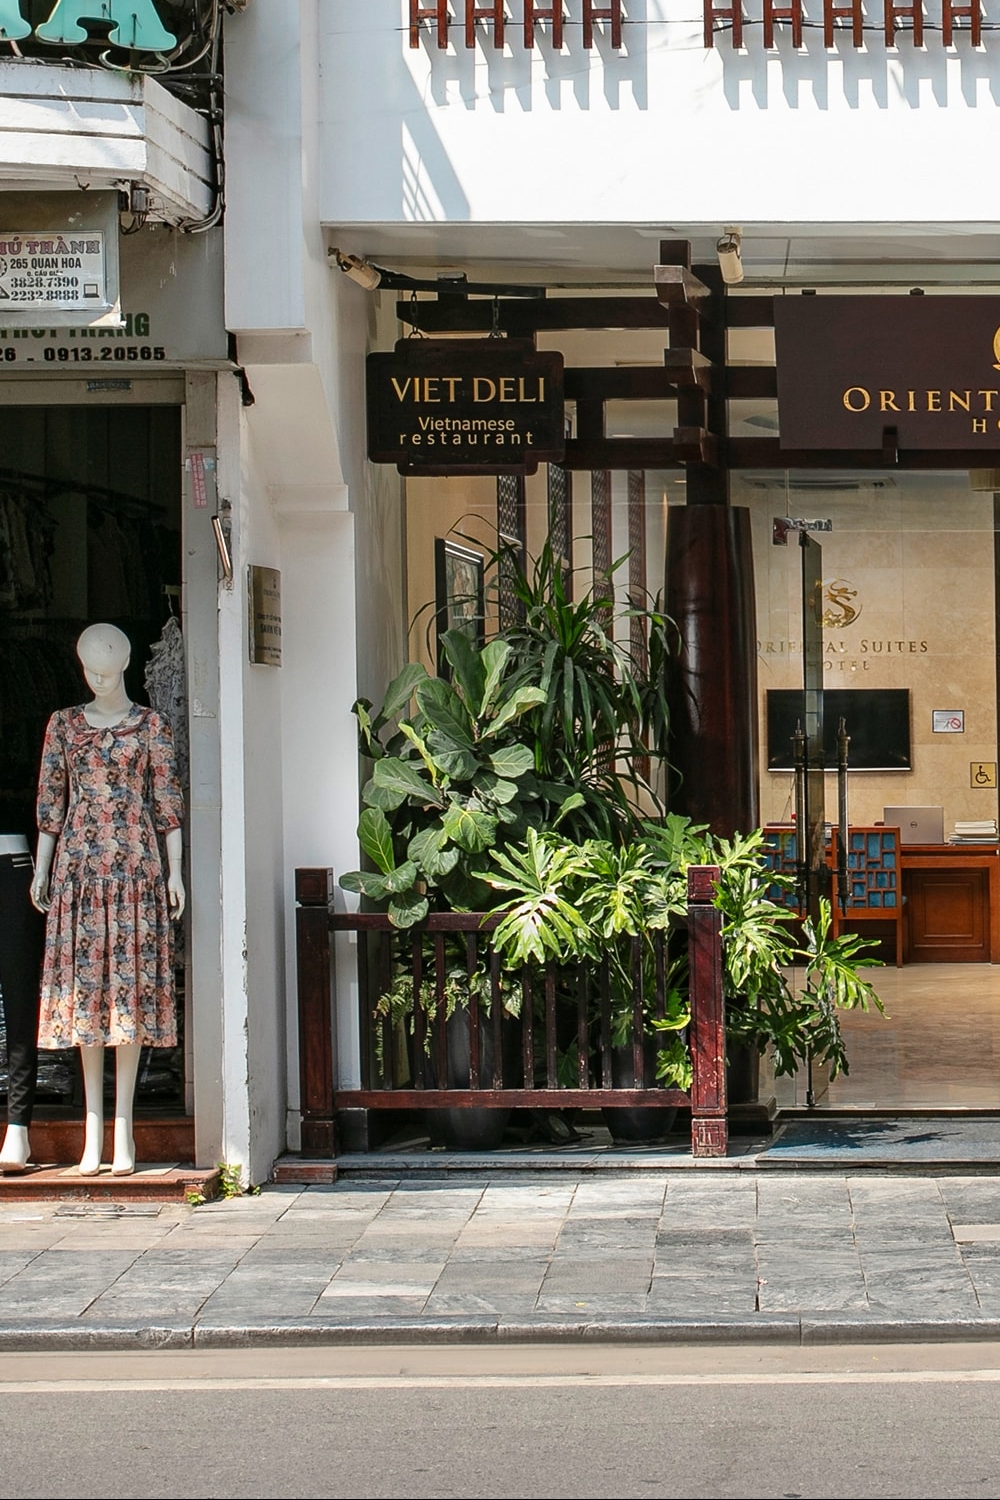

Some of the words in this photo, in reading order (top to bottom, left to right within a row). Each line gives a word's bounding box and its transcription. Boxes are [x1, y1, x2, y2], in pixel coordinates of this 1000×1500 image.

[26, 236, 100, 255] THÀNH
[10, 258, 28, 269] 265
[31, 257, 58, 270] QUAN
[61, 257, 82, 269] HOA
[10, 276, 79, 288] 3828.7390
[10, 289, 79, 301] 2232.8888
[43, 347, 166, 361] 0913.20565
[391, 377, 463, 402] VIET
[473, 377, 545, 402] DELI
[418, 416, 515, 431] Vietnamese
[400, 431, 533, 445] restaurant
[860, 639, 929, 653] SUITES
